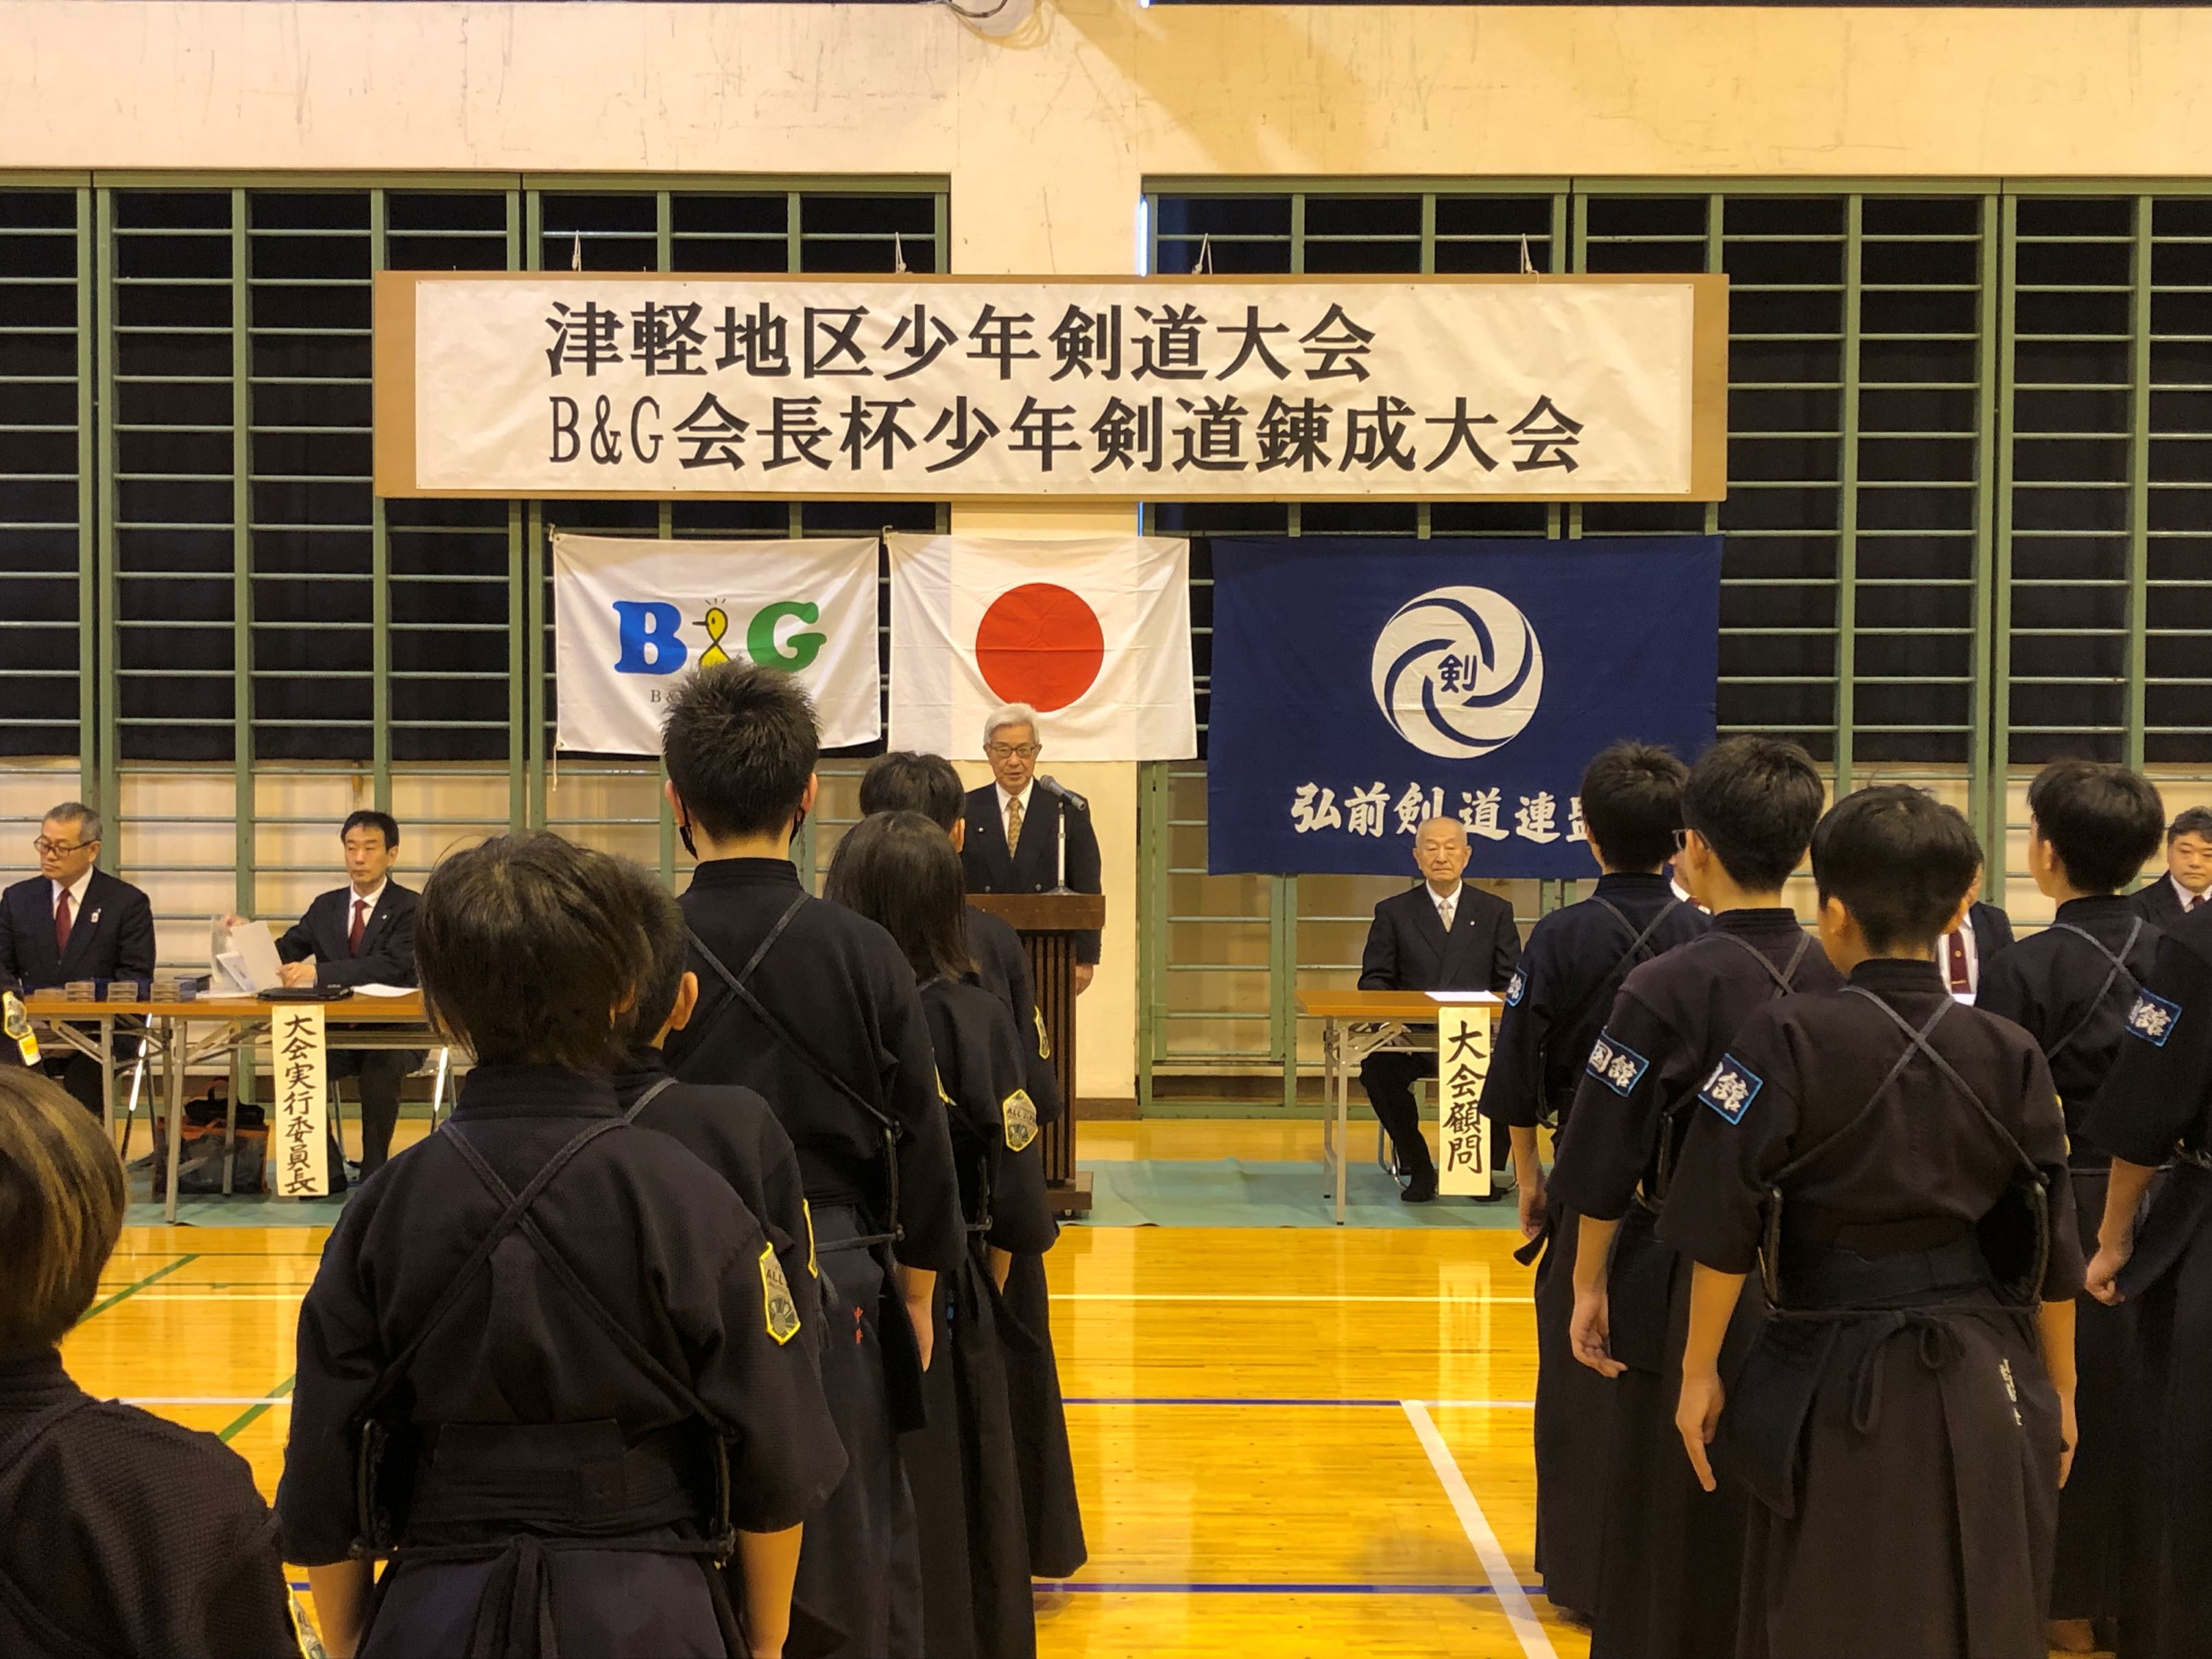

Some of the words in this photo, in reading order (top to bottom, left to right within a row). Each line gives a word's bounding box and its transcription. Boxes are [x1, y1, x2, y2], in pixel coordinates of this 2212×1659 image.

[545, 301, 1375, 382] 津軽地区少年剣道大会
[1438, 654, 1478, 694] 剣
[282, 1014, 318, 1194] 大会実行委員長
[1442, 1020, 1487, 1174] 大会顧問
